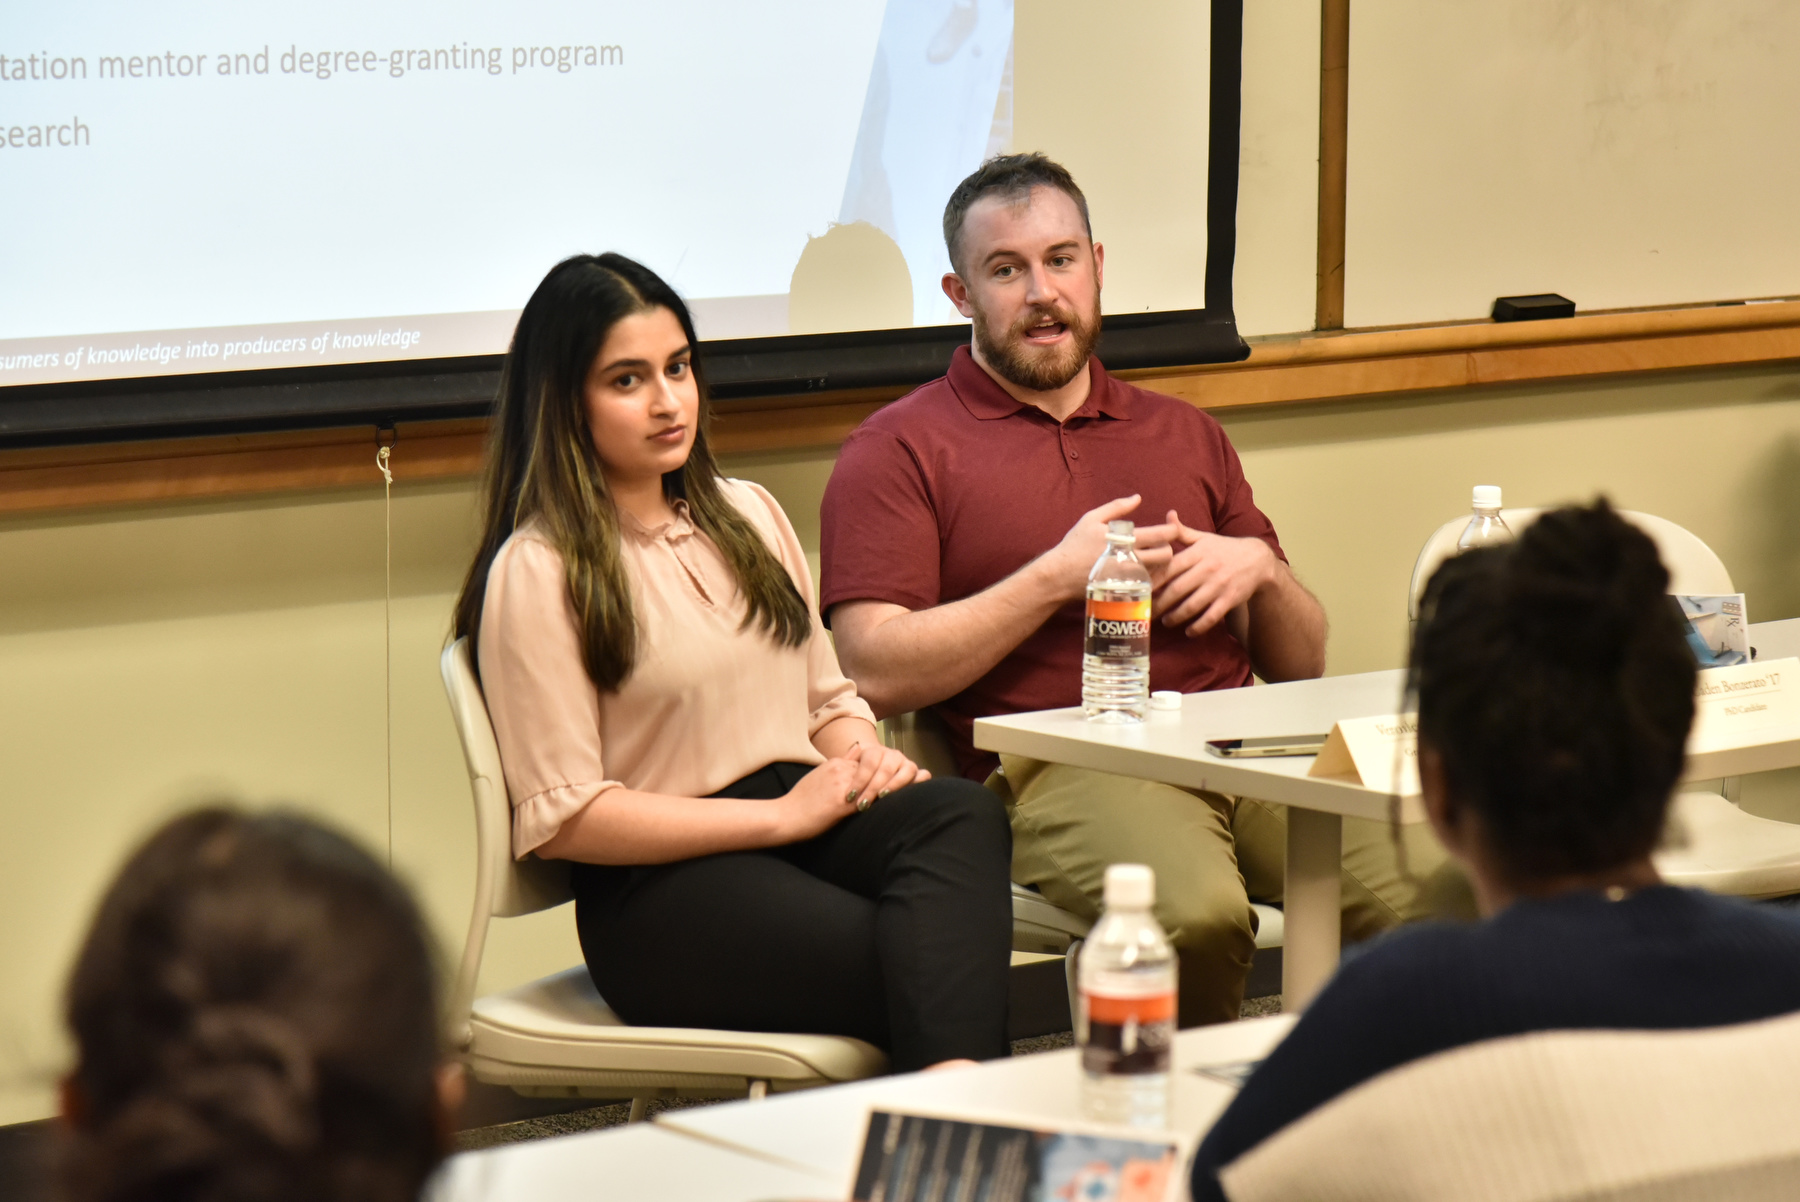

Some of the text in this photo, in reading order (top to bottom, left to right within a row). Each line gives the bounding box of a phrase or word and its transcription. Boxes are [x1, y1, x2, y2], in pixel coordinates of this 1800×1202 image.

[0, 42, 624, 80] tation mentor and degree-granting program
[64, 346, 84, 370] of
[87, 342, 182, 365] knowledge
[186, 340, 219, 359] into
[223, 336, 307, 361] producers
[311, 332, 330, 354] of
[333, 328, 421, 349] knowledge
[1098, 620, 1150, 635] OSWEGO
